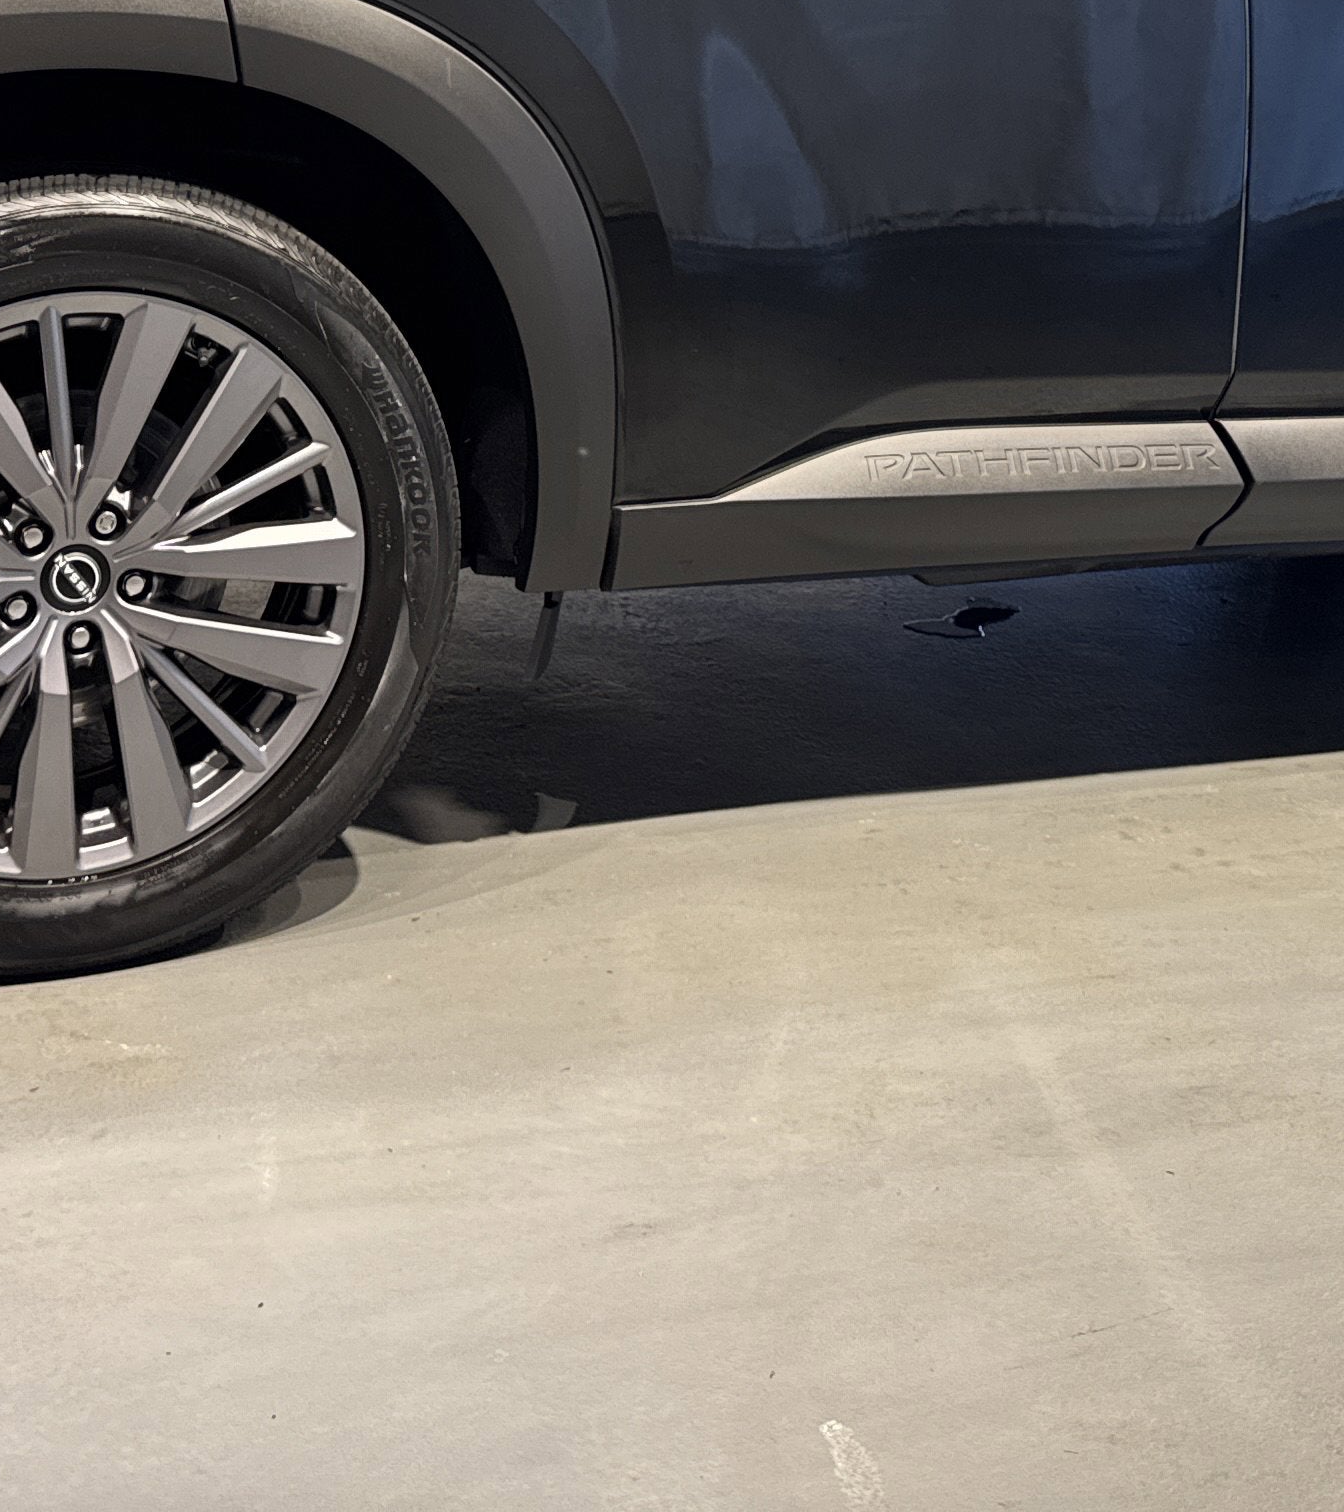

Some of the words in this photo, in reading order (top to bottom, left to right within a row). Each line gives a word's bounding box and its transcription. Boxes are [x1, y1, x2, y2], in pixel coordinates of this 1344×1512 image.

[372, 389, 432, 557] Hankook
[863, 443, 1221, 482] PATHFINDER
[54, 553, 97, 604] NISSAN
